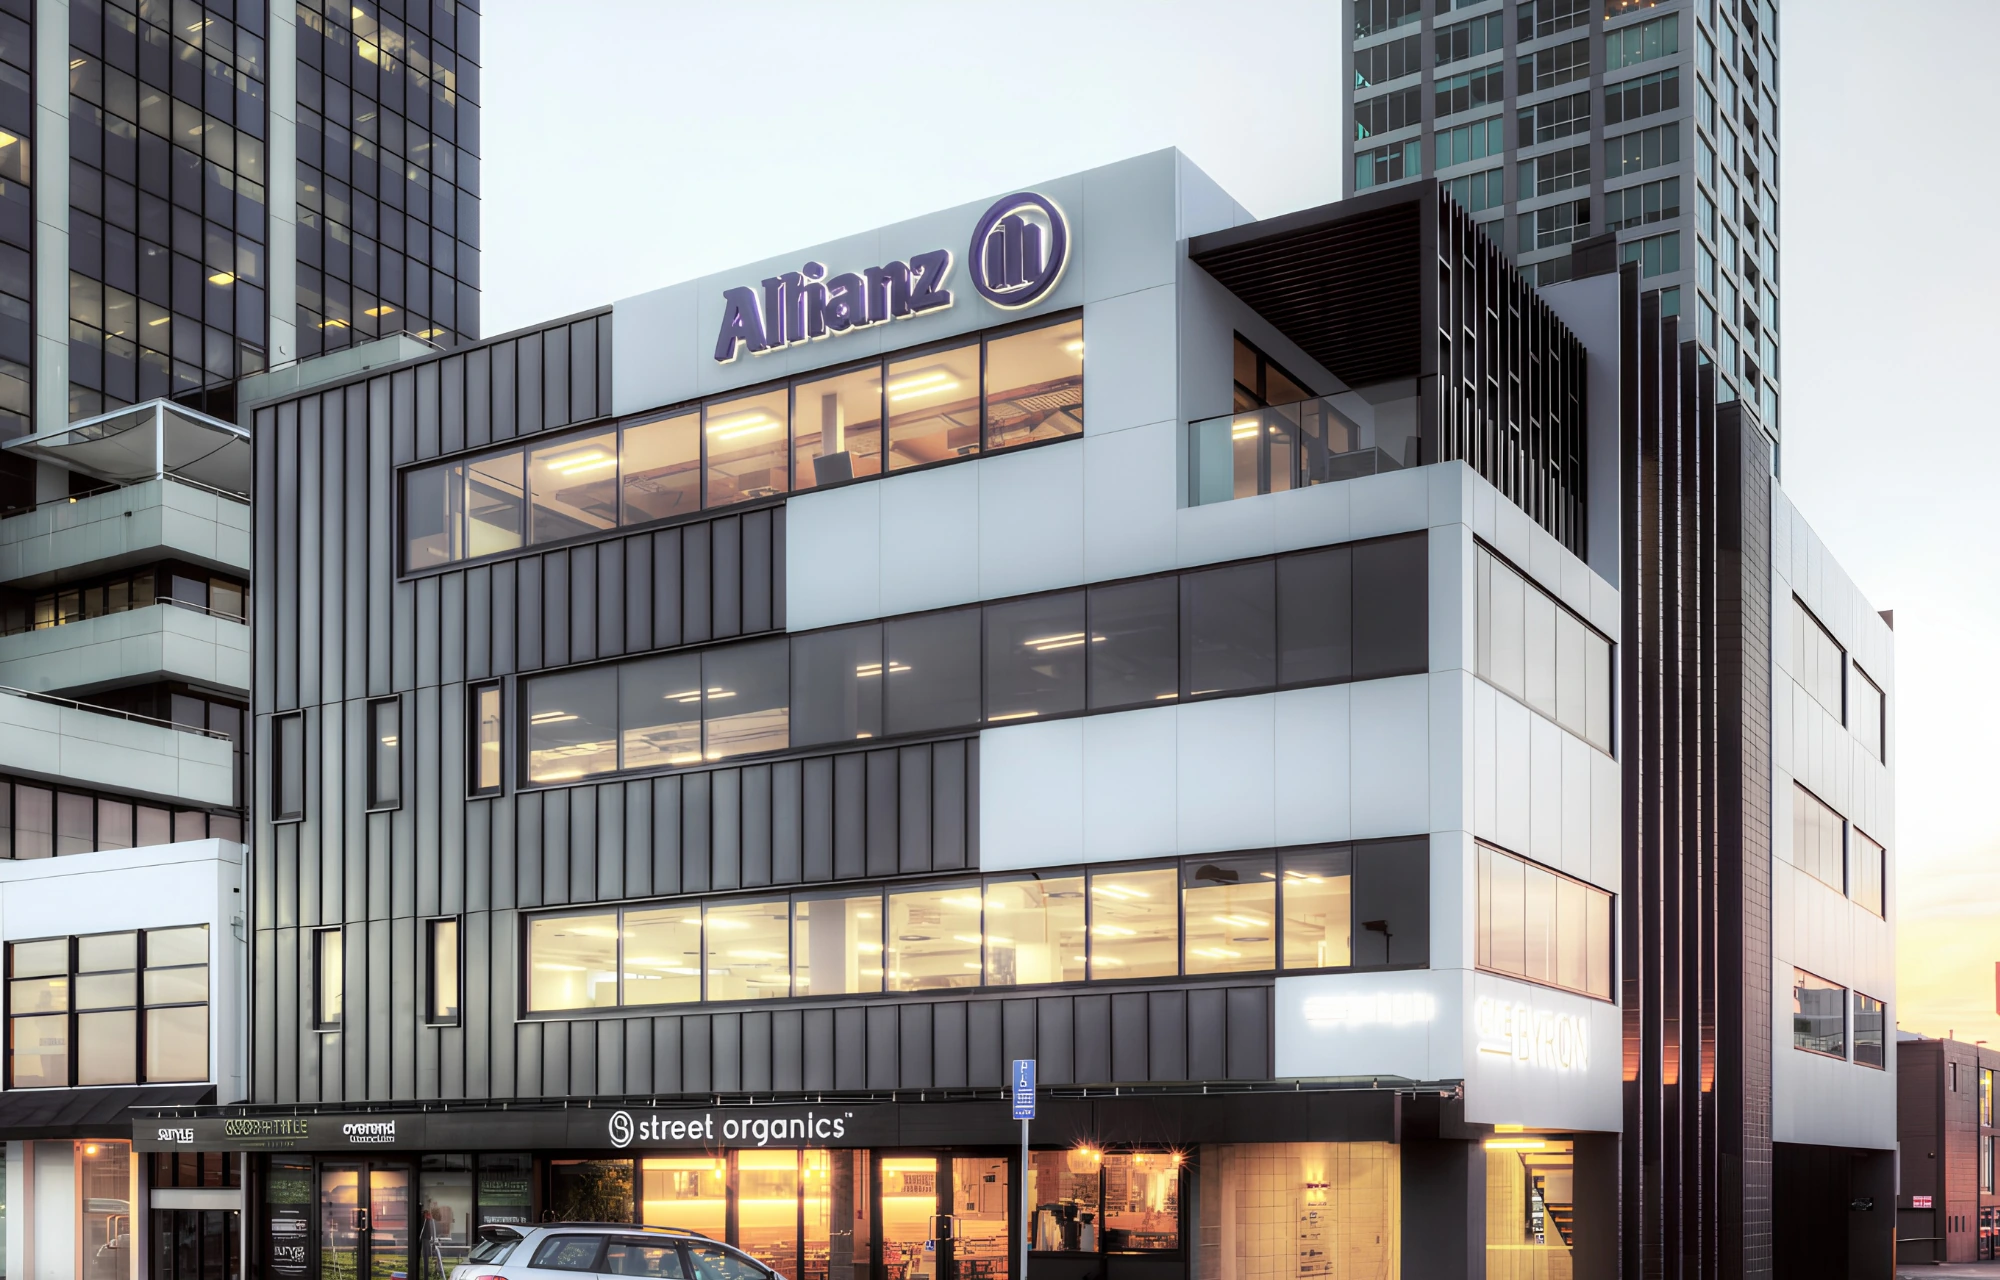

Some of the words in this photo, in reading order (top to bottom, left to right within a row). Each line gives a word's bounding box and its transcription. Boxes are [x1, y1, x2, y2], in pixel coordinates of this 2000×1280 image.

[714, 249, 953, 364] Allianz
[639, 1113, 714, 1140] street
[722, 1112, 845, 1146] organics
